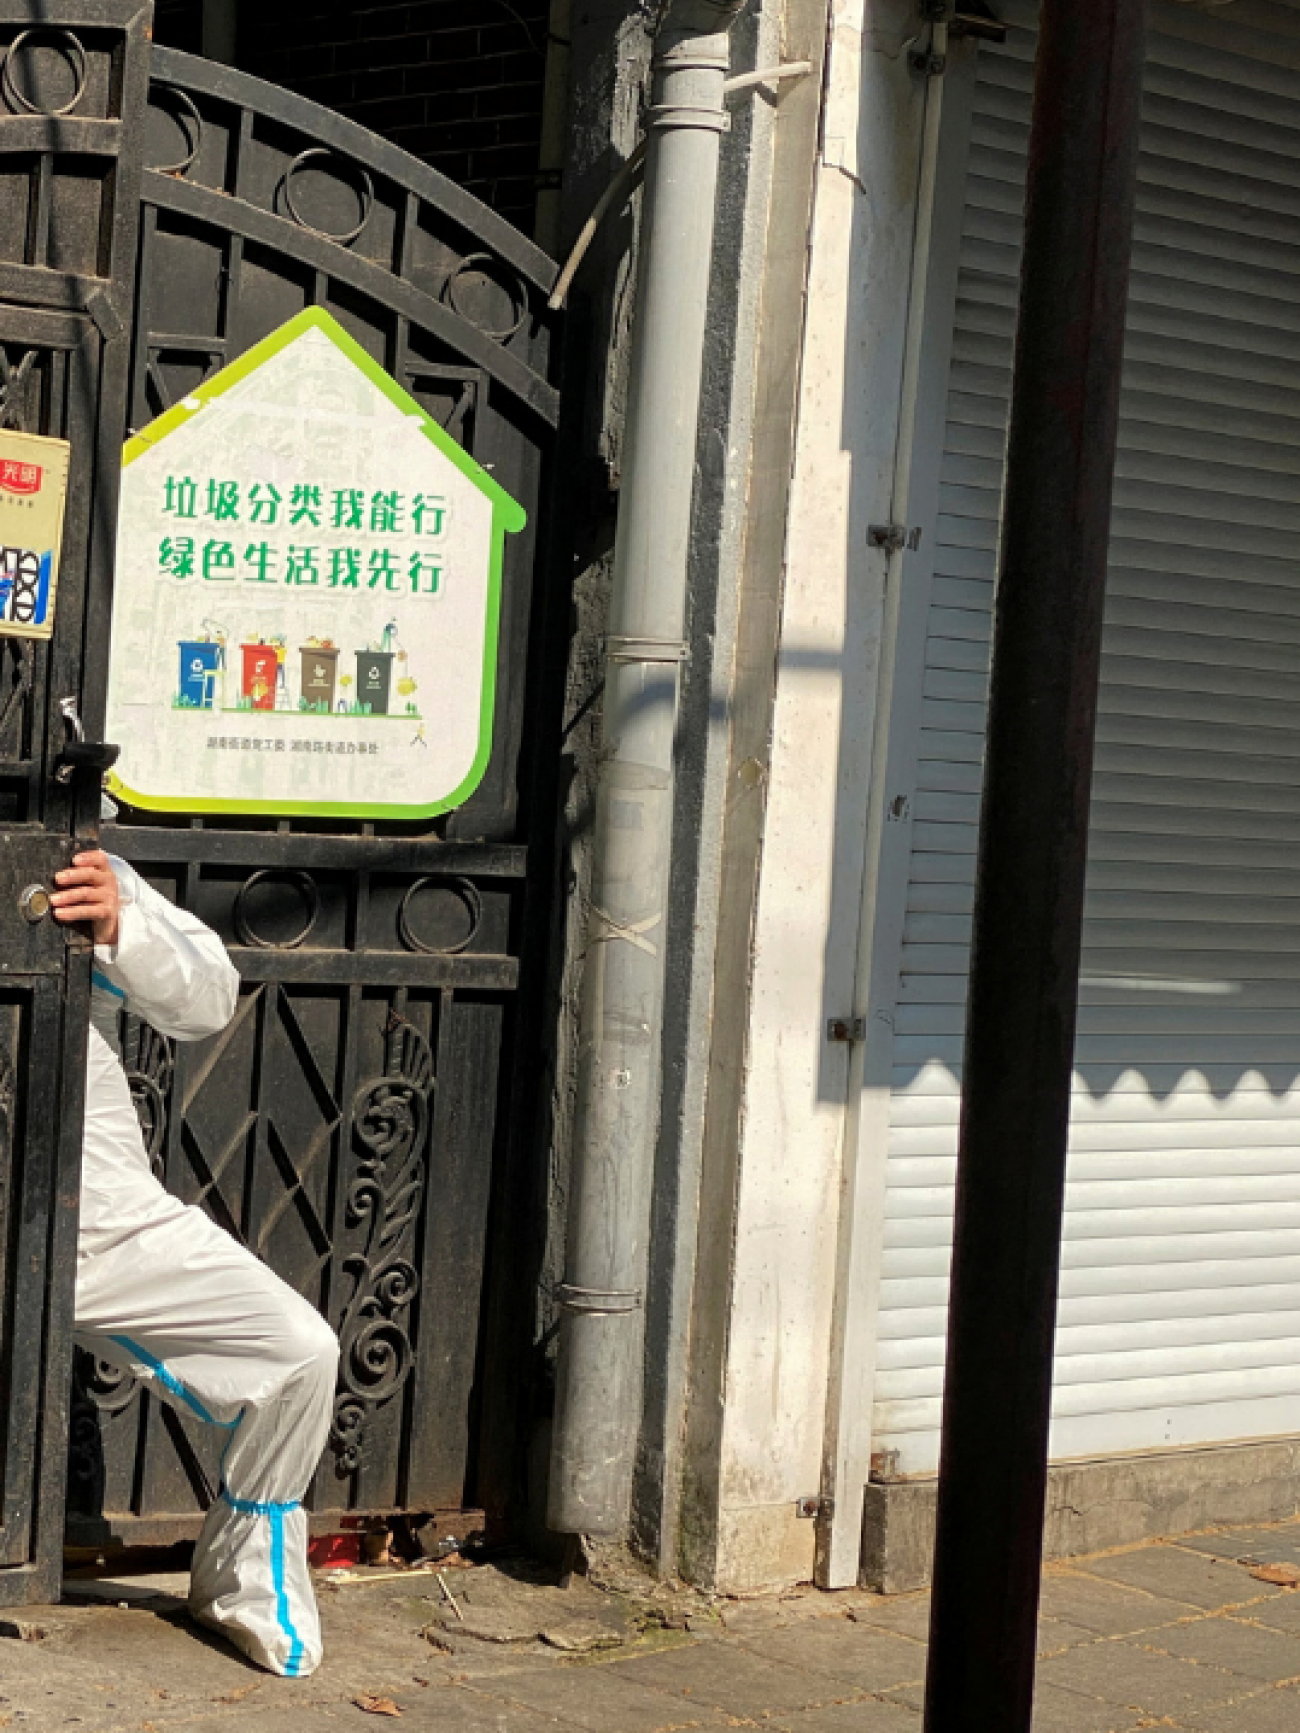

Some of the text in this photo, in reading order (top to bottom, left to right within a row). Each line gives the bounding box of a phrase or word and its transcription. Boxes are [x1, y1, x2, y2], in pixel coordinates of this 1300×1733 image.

[2, 461, 37, 485] 光明
[162, 474, 447, 536] 垃圾分类我能行
[158, 536, 444, 593] 绿色生活我先行
